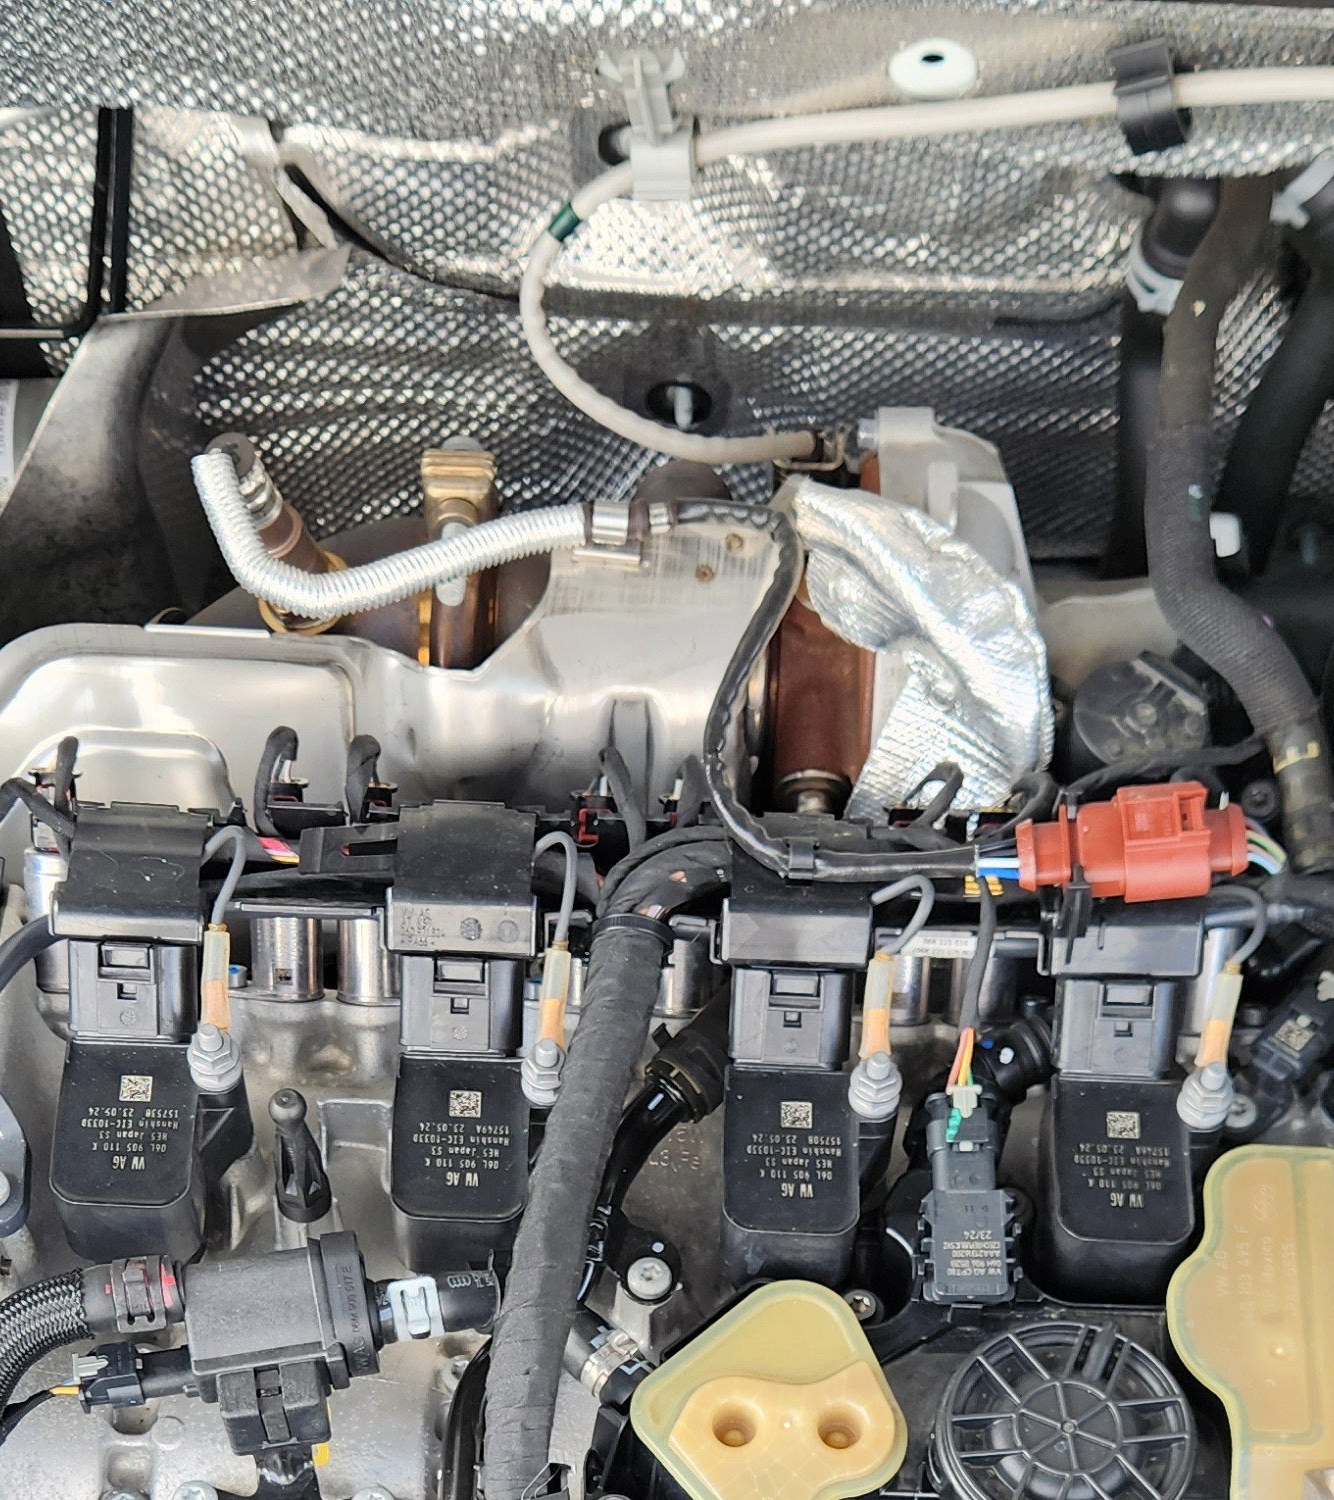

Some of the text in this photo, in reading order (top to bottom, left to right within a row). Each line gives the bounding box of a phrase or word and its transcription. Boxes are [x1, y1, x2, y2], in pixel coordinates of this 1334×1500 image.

[88, 1107, 135, 1117] 23.05.24
[138, 1120, 179, 1130] Hanshin
[419, 1122, 465, 1133] 23.05.24
[116, 1130, 145, 1140] Japan
[469, 1136, 510, 1146] Hanshin
[91, 1142, 167, 1153] 06L 905 110 K
[448, 1146, 477, 1157] Japan
[802, 1147, 843, 1157] Hanshin
[112, 1155, 146, 1170] VW AG
[424, 1157, 500, 1170] 06L 905 110 K
[781, 1157, 810, 1168] Japan
[445, 1171, 479, 1187] VW AG
[759, 1169, 833, 1180] 06L 905 110 K
[781, 1183, 814, 1198] VW AG
[963, 1230, 993, 1240] 23/24
